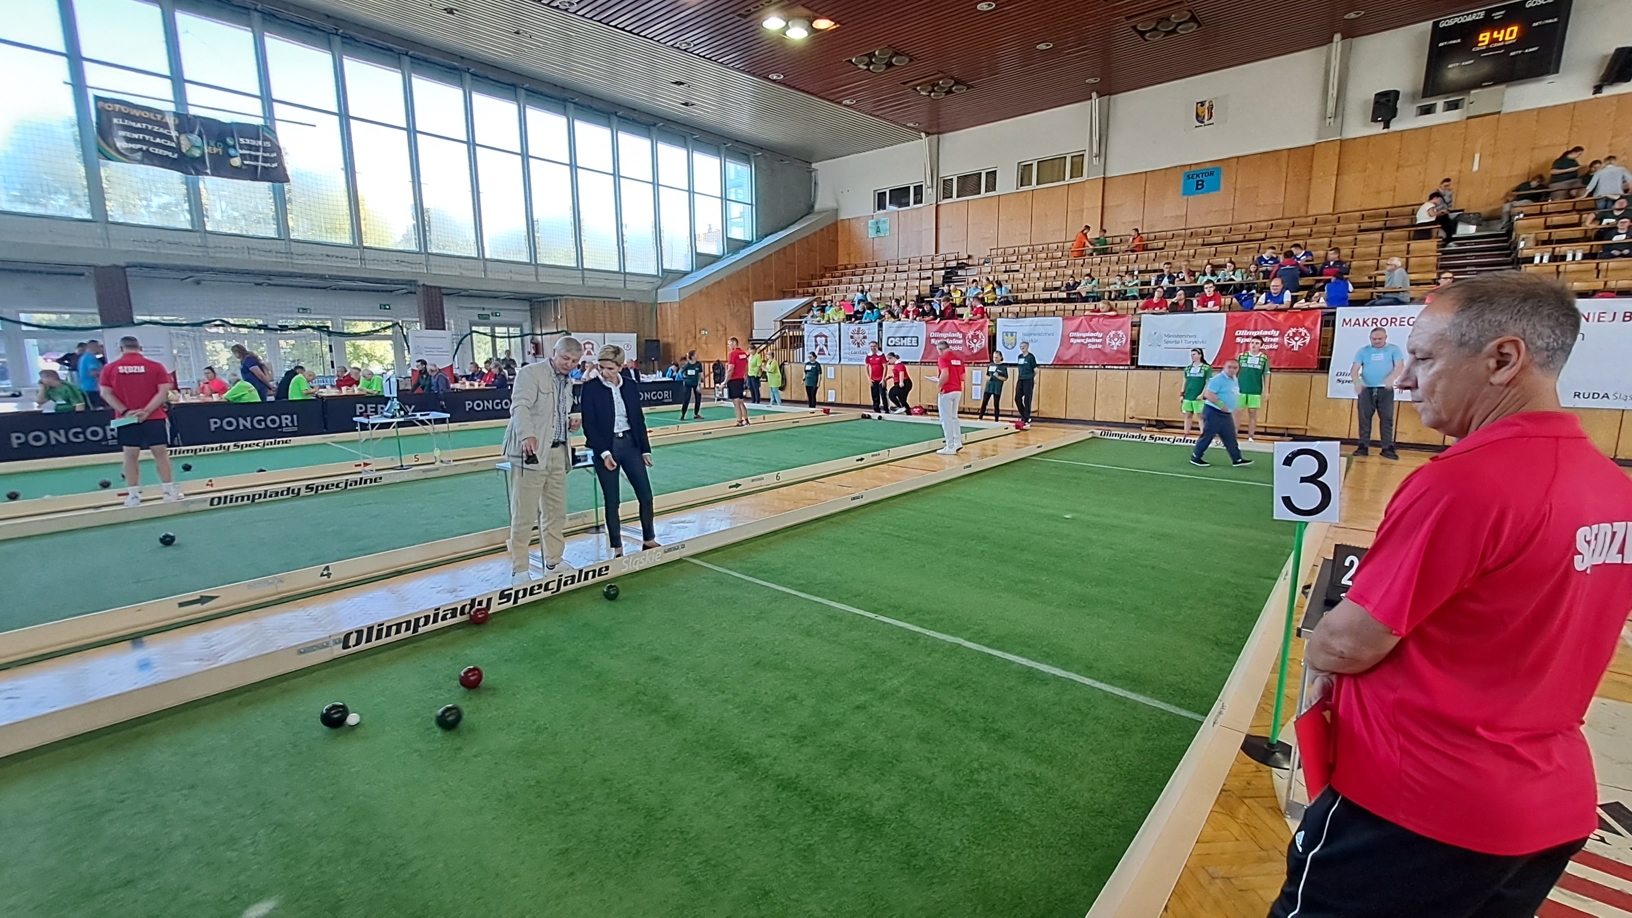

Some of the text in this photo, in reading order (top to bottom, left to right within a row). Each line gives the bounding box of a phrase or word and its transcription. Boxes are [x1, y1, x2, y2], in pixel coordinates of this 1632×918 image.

[1186, 170, 1215, 180] SEKTOR
[1195, 179, 1205, 191] B
[1341, 316, 1417, 328] MAKROREG
[1235, 329, 1280, 337] Olimpiady
[887, 336, 918, 346] OSHEE
[385, 378, 393, 396] 1
[1572, 391, 1611, 400] RUDA
[209, 414, 298, 431] PONGORI
[10, 425, 118, 448] PONGOR
[1100, 430, 1147, 441] Olimpiady
[232, 439, 292, 451] Specjalne
[775, 472, 781, 481] 6
[1281, 448, 1332, 516] 3
[205, 479, 214, 487] 4
[209, 475, 383, 507] Olimpiady Specjalne
[320, 565, 332, 579] 4
[1341, 555, 1359, 586] 2
[341, 596, 493, 651] Olimpiady
[498, 564, 610, 606] Specjalne
[621, 550, 661, 572] Śląskie
